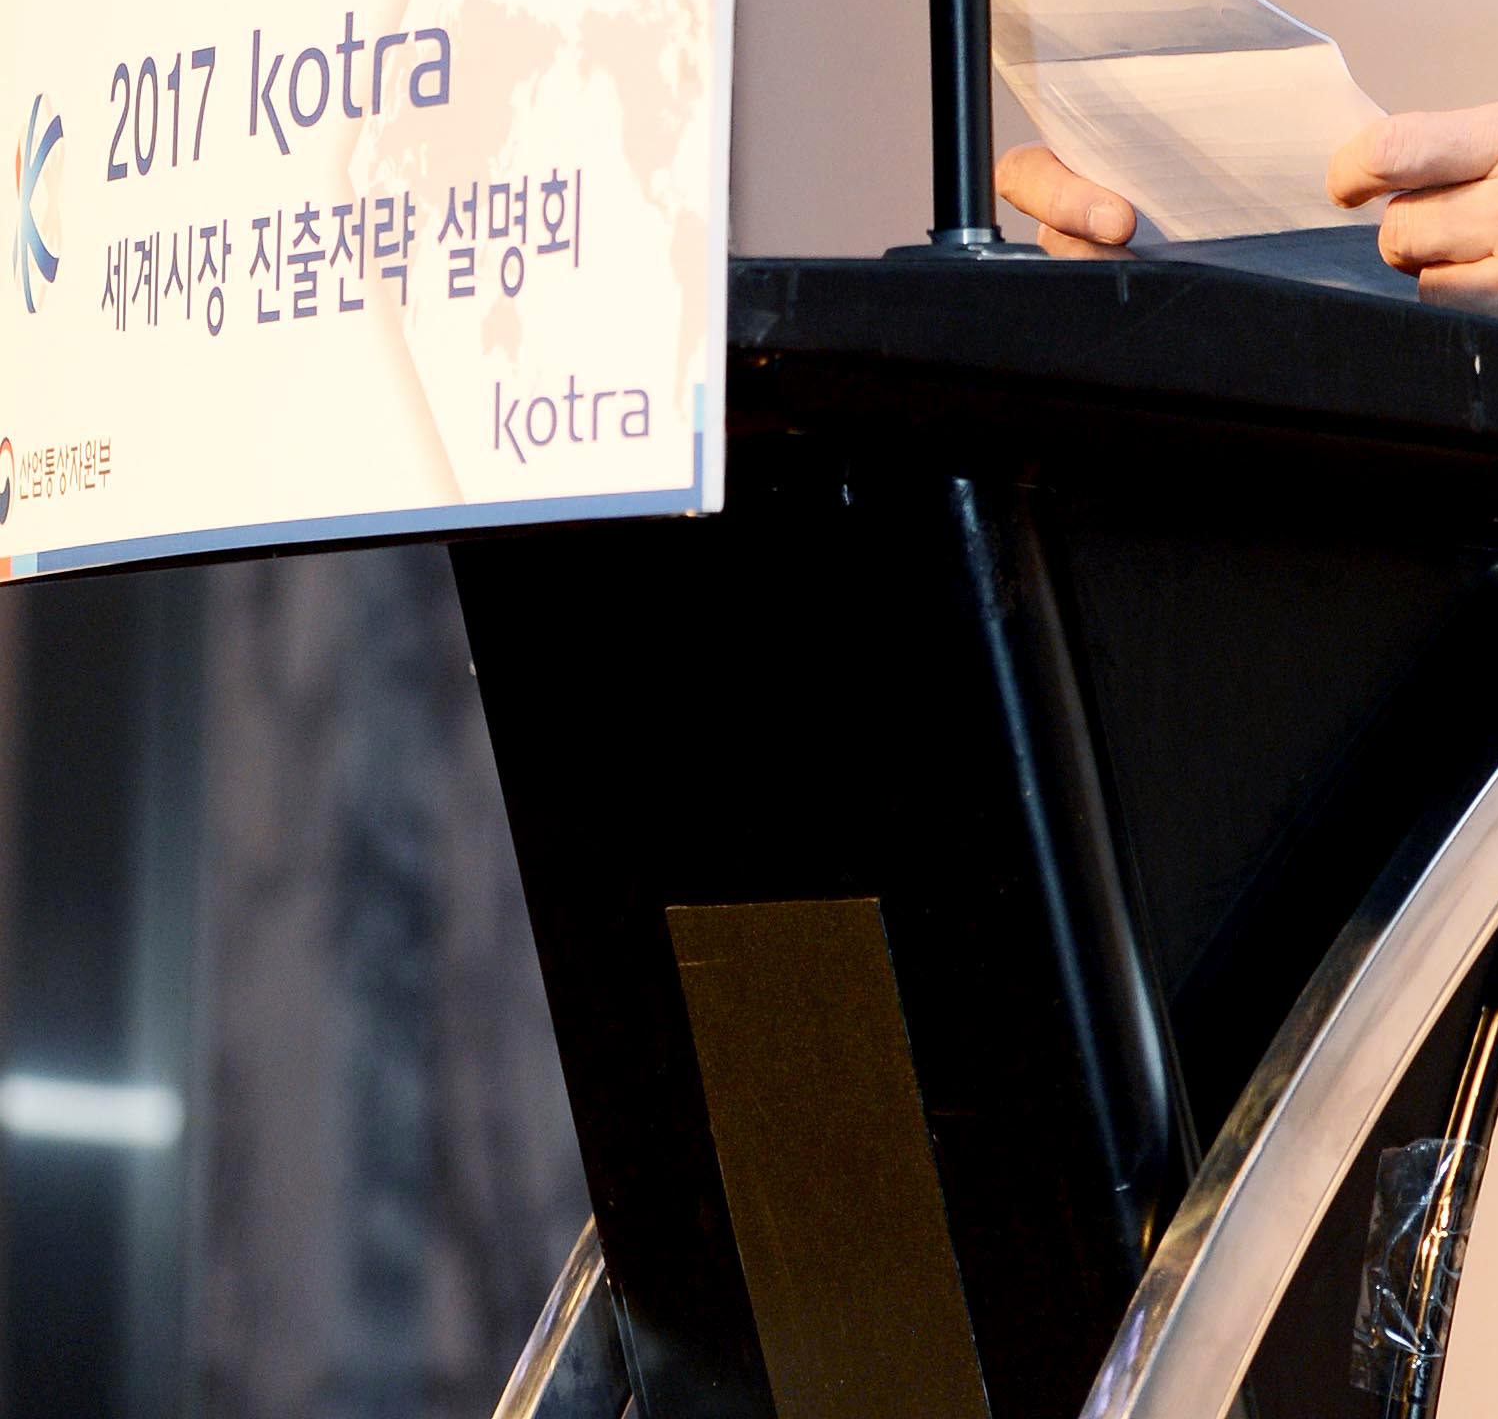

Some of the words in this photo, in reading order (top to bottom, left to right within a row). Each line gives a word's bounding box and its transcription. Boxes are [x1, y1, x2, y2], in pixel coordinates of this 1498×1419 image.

[106, 46, 217, 182] 2017
[248, 10, 451, 156] kotra
[101, 218, 232, 337] 세계시장
[248, 191, 417, 325] 진출전략
[437, 167, 582, 299] 설명회
[19, 437, 112, 501] 산업통상자원부
[494, 374, 650, 465] kotra
